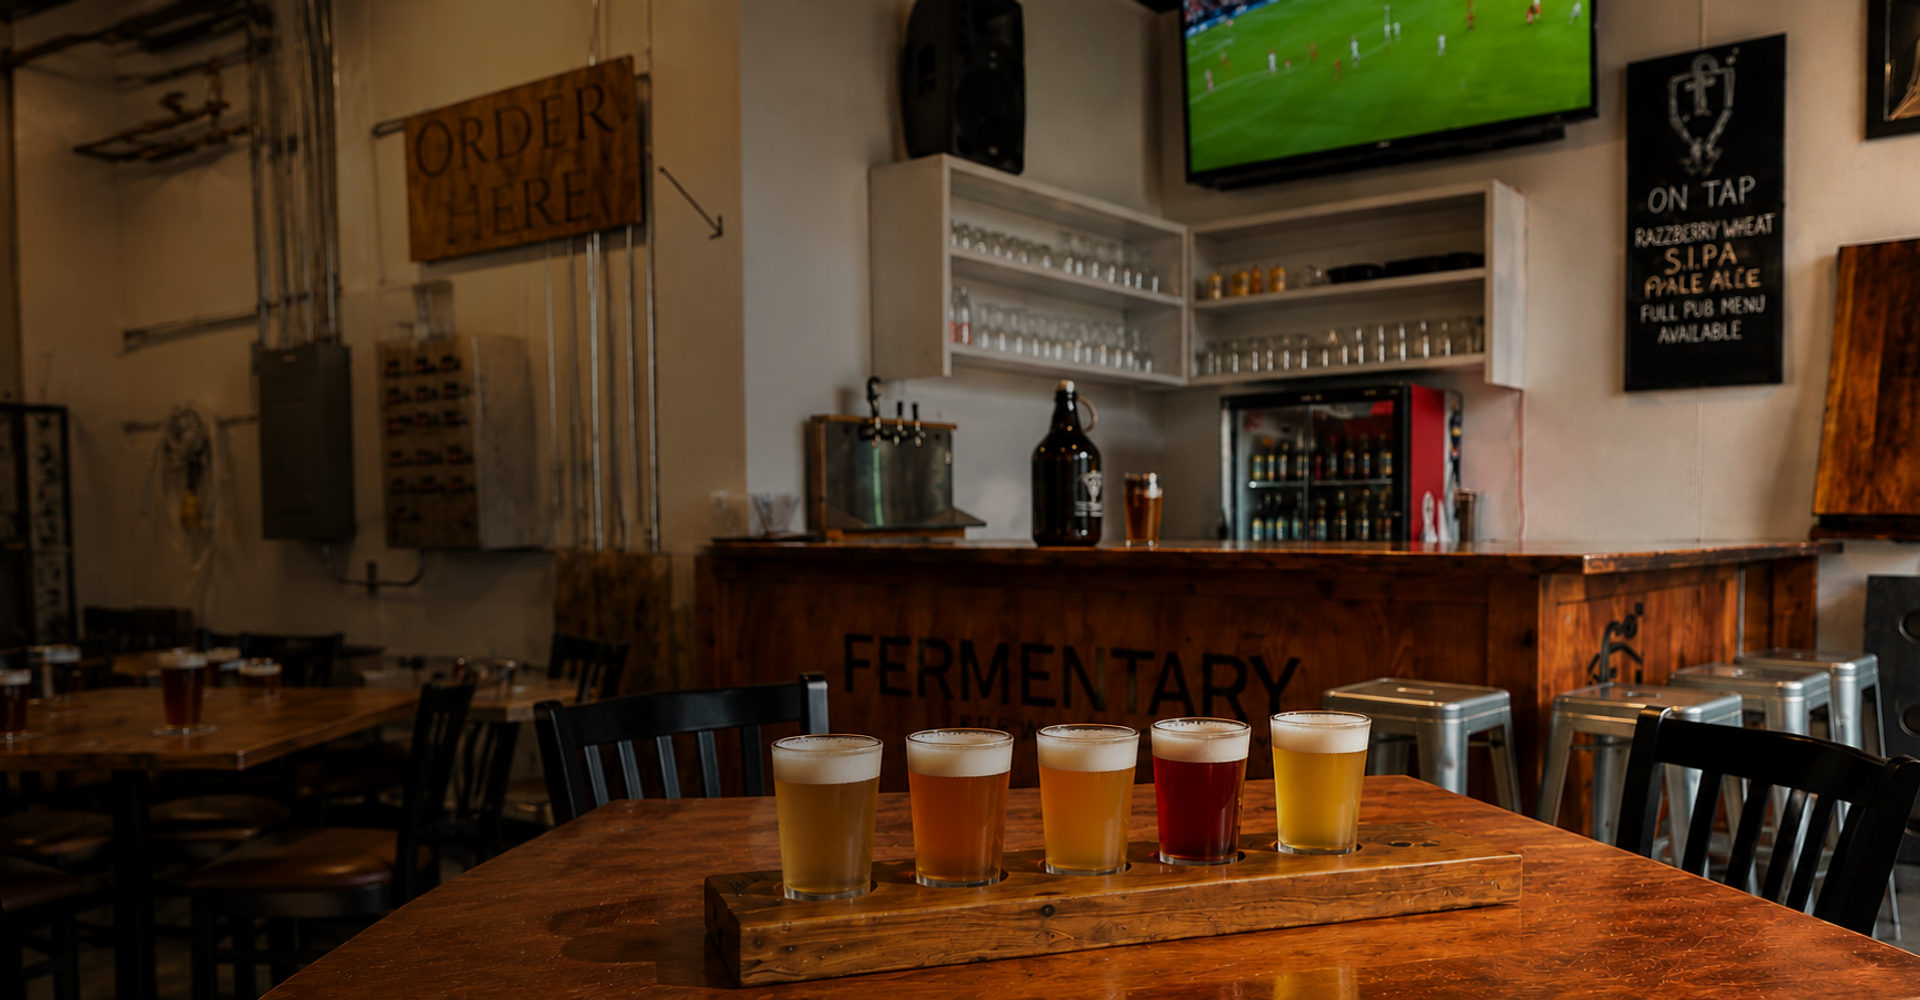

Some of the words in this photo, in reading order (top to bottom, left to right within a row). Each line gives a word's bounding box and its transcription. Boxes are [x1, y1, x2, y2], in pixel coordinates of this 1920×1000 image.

[415, 83, 615, 178] ORDER
[446, 167, 593, 246] HERE
[1647, 184, 1688, 214] ON
[1701, 175, 1756, 208] TAP
[1721, 212, 1776, 239] WHEAT
[1640, 303, 1679, 325] FULL
[1683, 298, 1715, 320] PUB
[1720, 294, 1766, 316] MENU
[1657, 319, 1743, 345] AVAILABLE
[845, 634, 1300, 722] FERMENTARY
